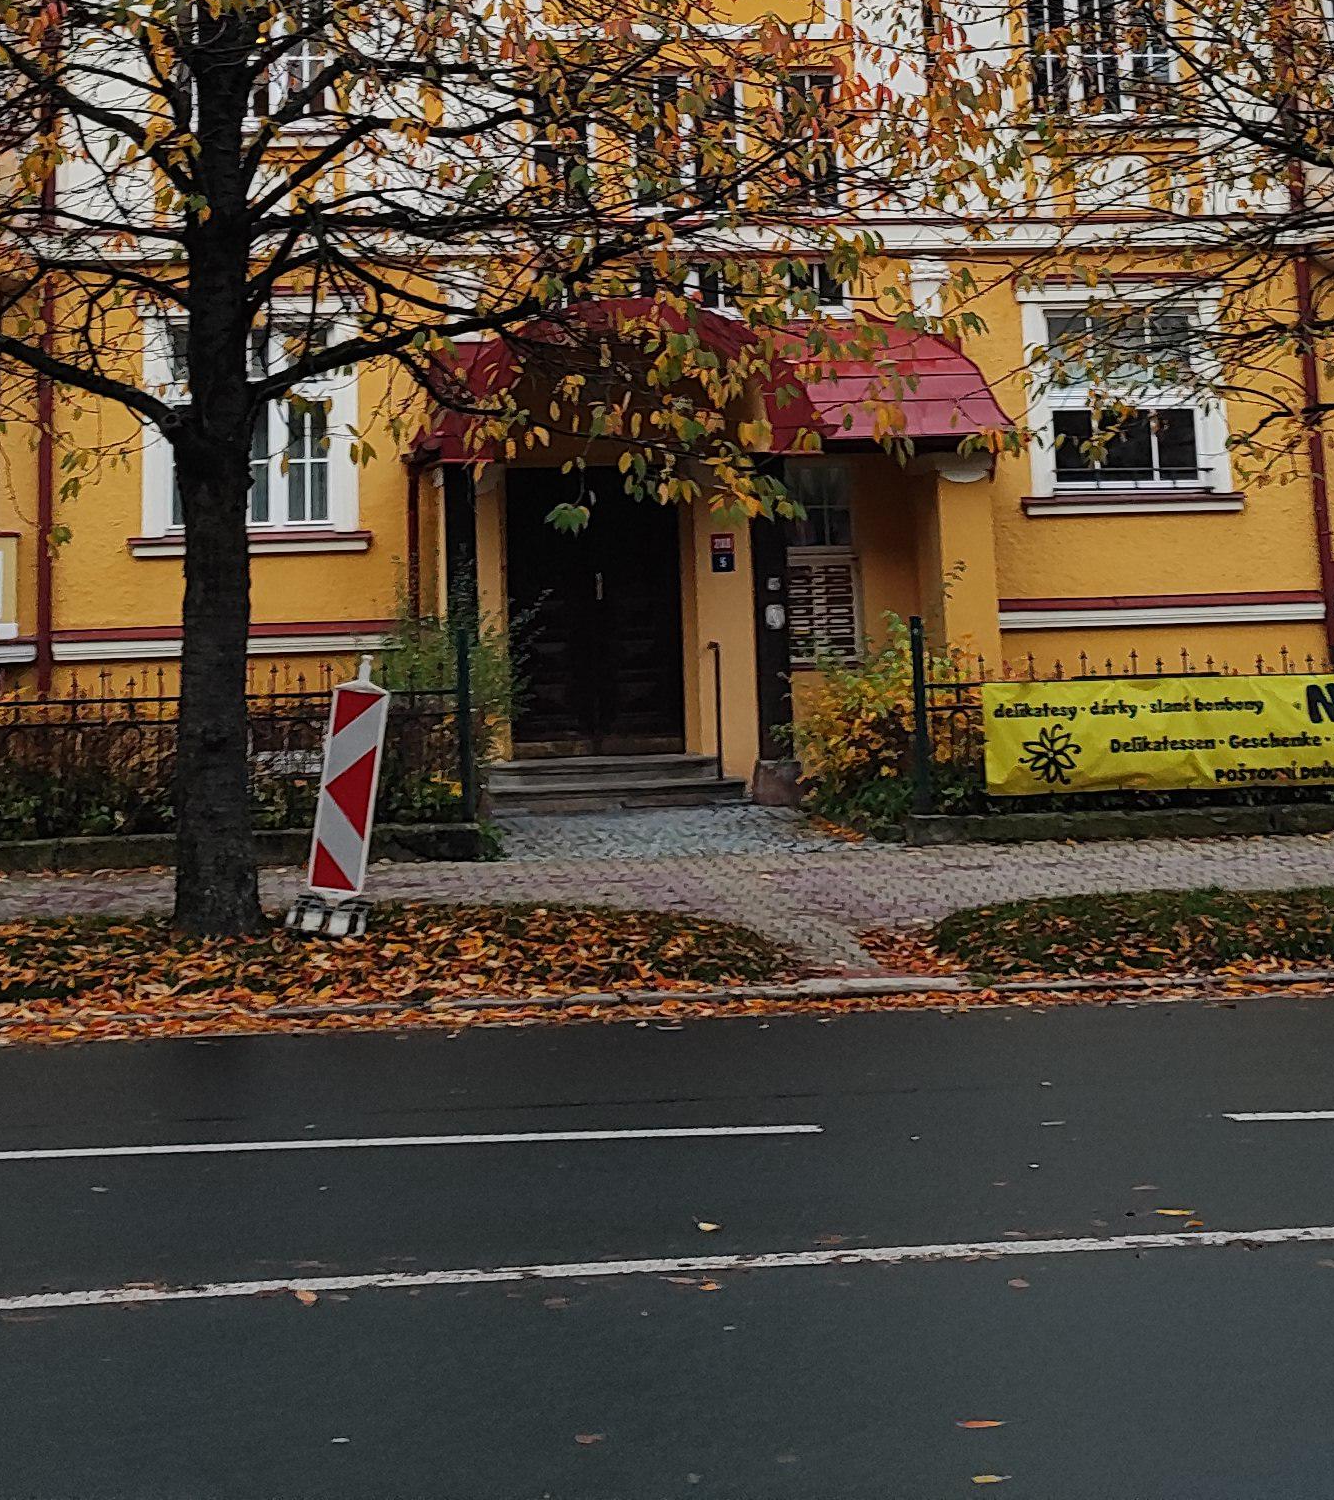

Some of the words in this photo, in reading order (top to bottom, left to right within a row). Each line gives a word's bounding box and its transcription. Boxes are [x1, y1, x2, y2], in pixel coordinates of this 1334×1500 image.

[993, 702, 1078, 721] delikatesy
[1089, 699, 1138, 719] dárky
[1110, 736, 1216, 753] Delikatessen
[1228, 730, 1322, 749] Geschenke
